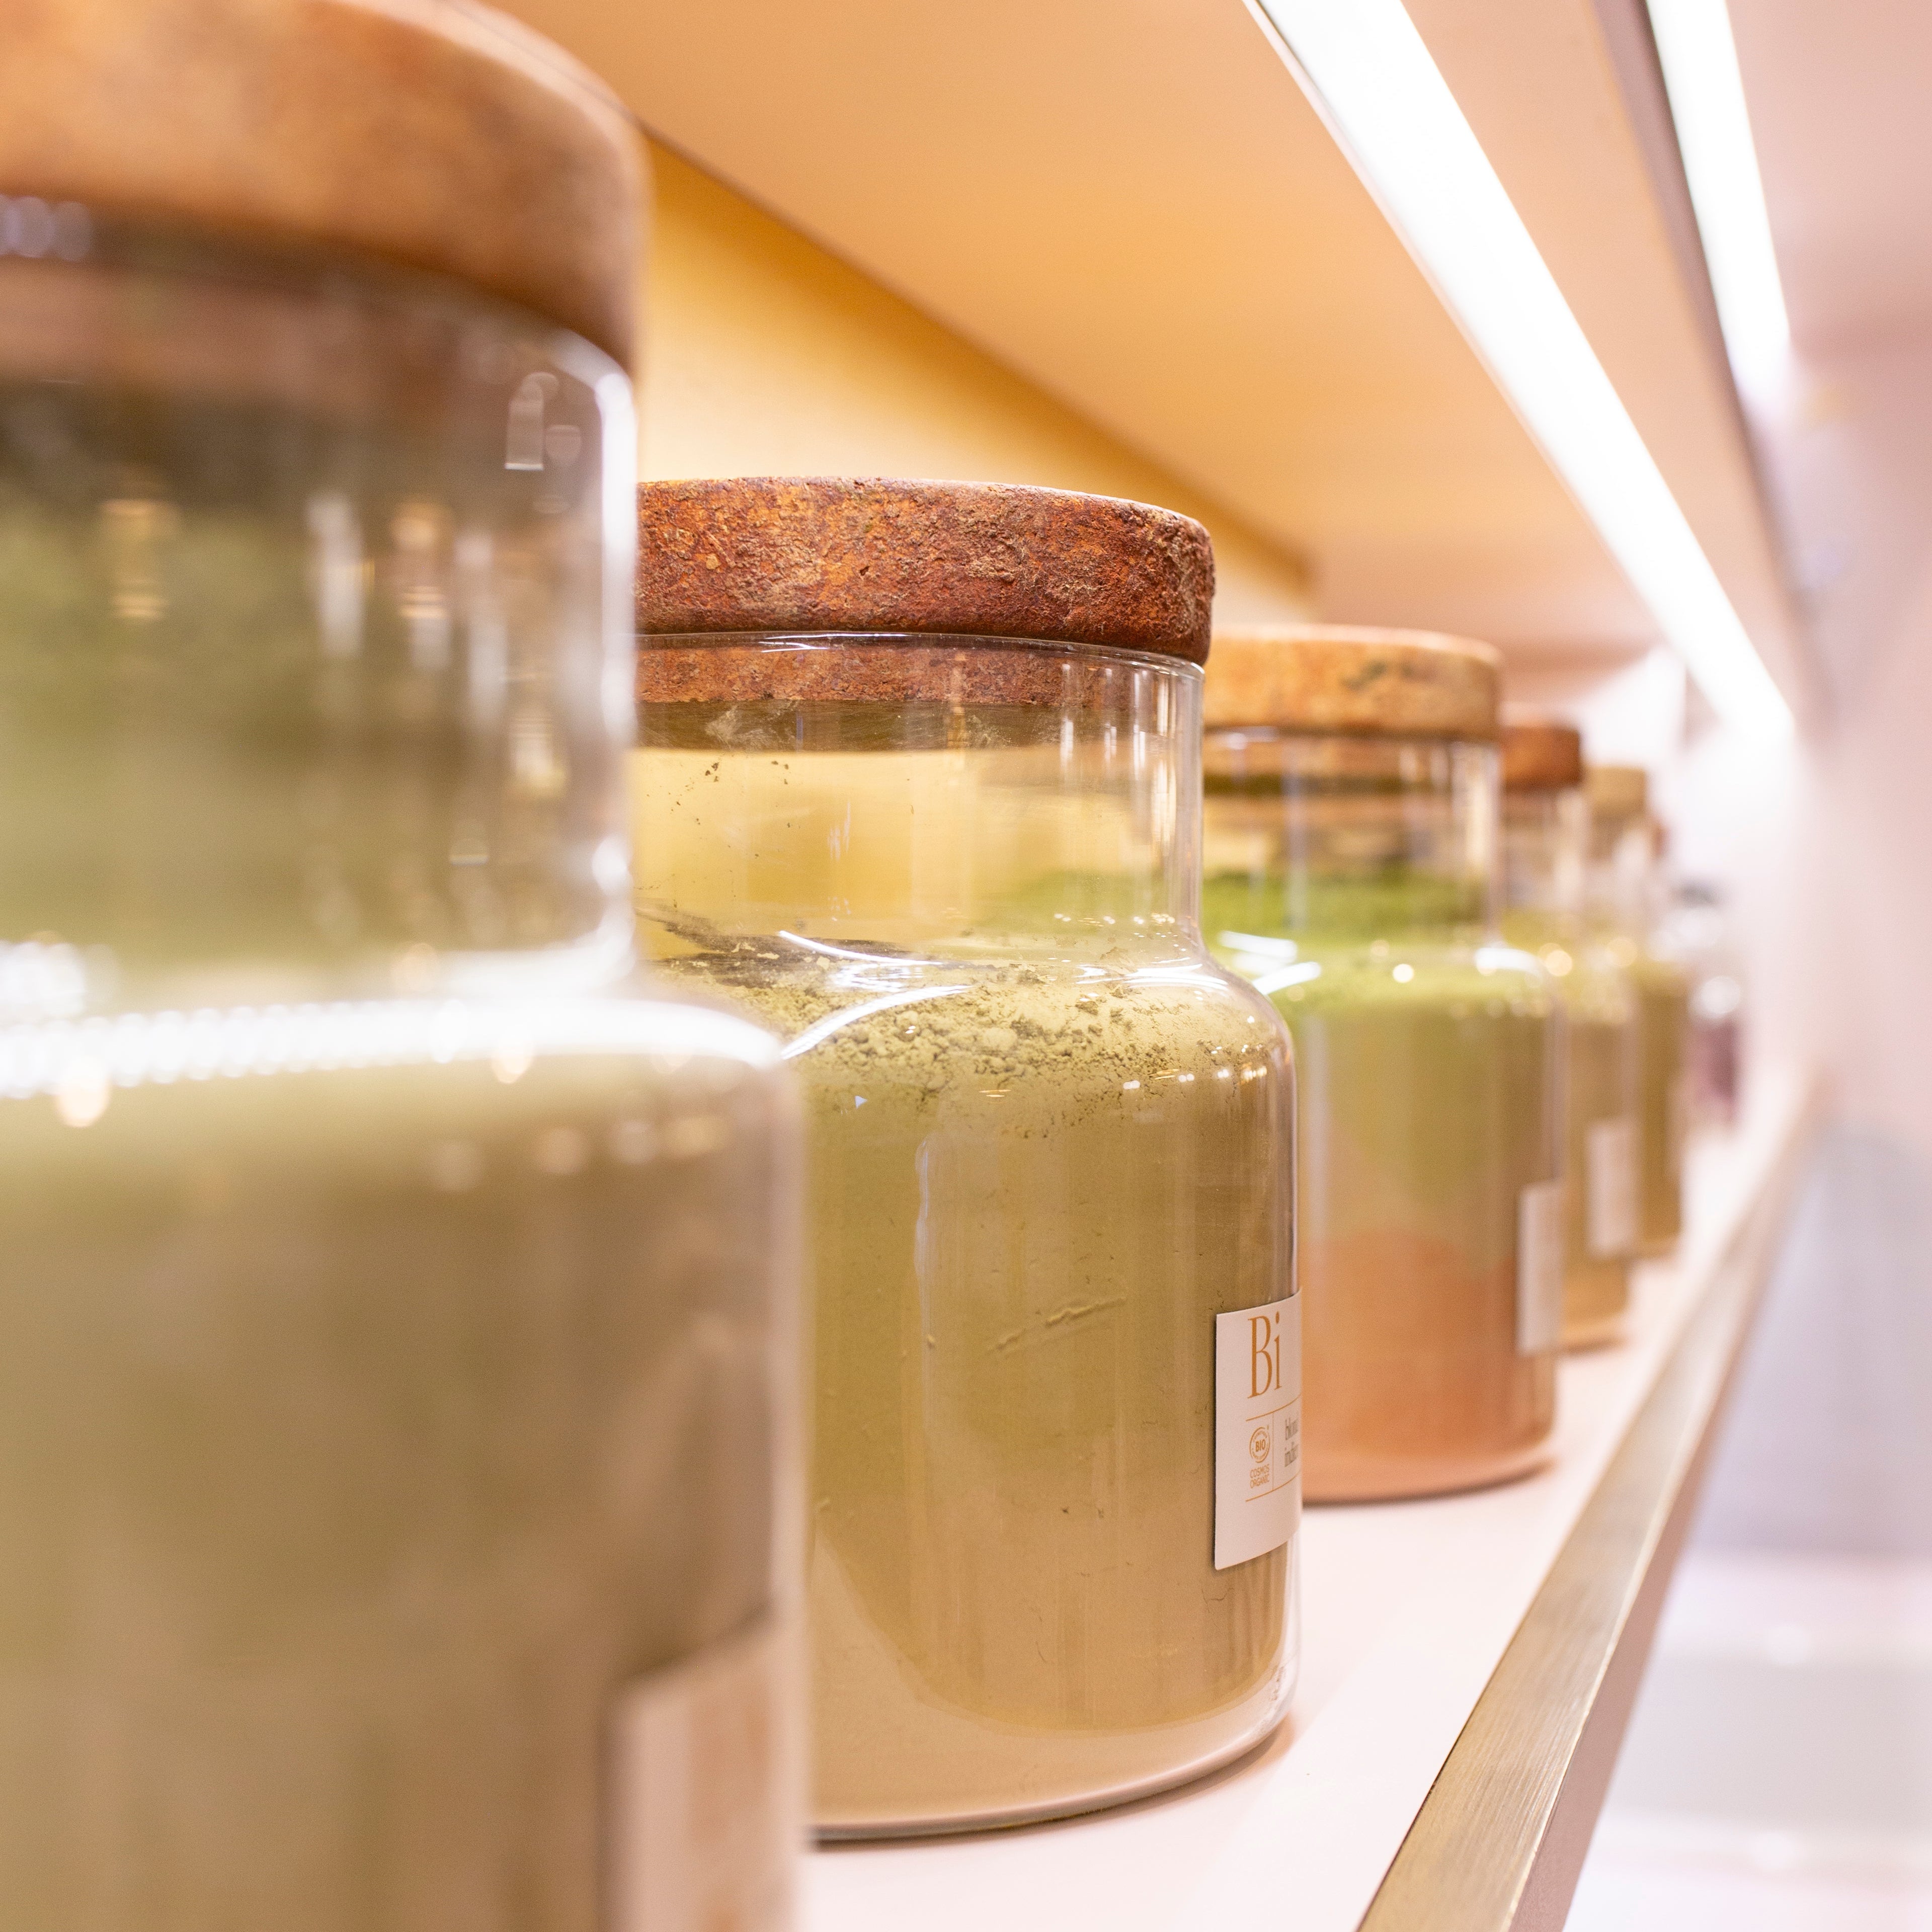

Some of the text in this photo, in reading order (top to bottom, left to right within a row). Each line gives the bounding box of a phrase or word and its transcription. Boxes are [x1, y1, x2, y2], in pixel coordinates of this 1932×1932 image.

[1247, 1310, 1282, 1399] Bi
[1255, 1439, 1266, 1453] BIO
[1250, 1463, 1270, 1478] COSMOS
[1250, 1473, 1270, 1489] ORGANIC
